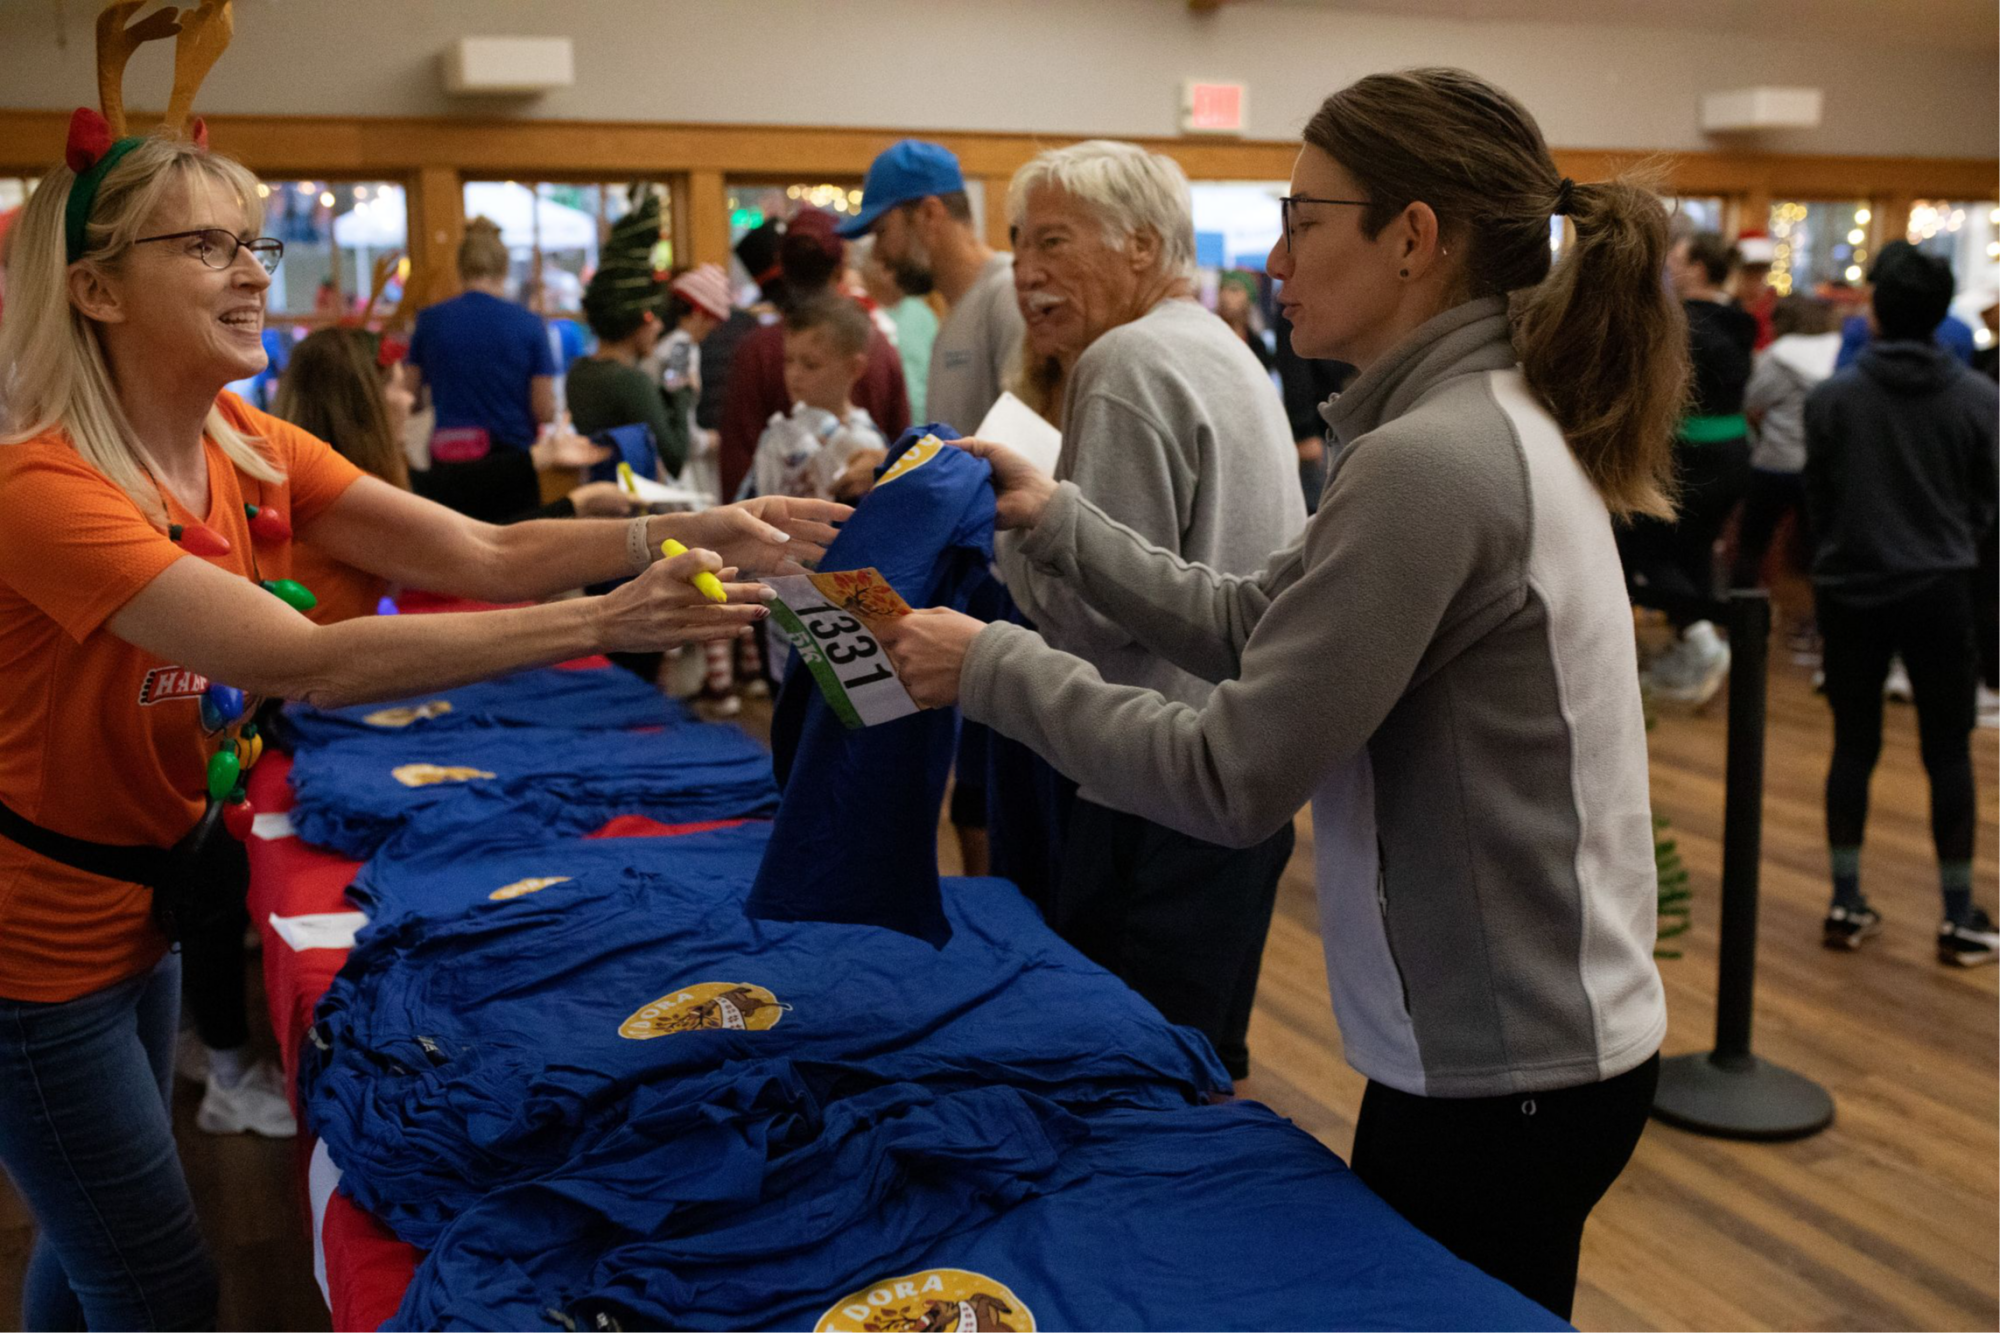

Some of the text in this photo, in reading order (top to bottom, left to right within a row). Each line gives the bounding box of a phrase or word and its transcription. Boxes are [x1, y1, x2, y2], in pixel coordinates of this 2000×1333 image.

[790, 631, 822, 664] 5K
[795, 602, 894, 689] 1331
[630, 993, 695, 1029] DORA
[843, 1274, 943, 1321] DORA
